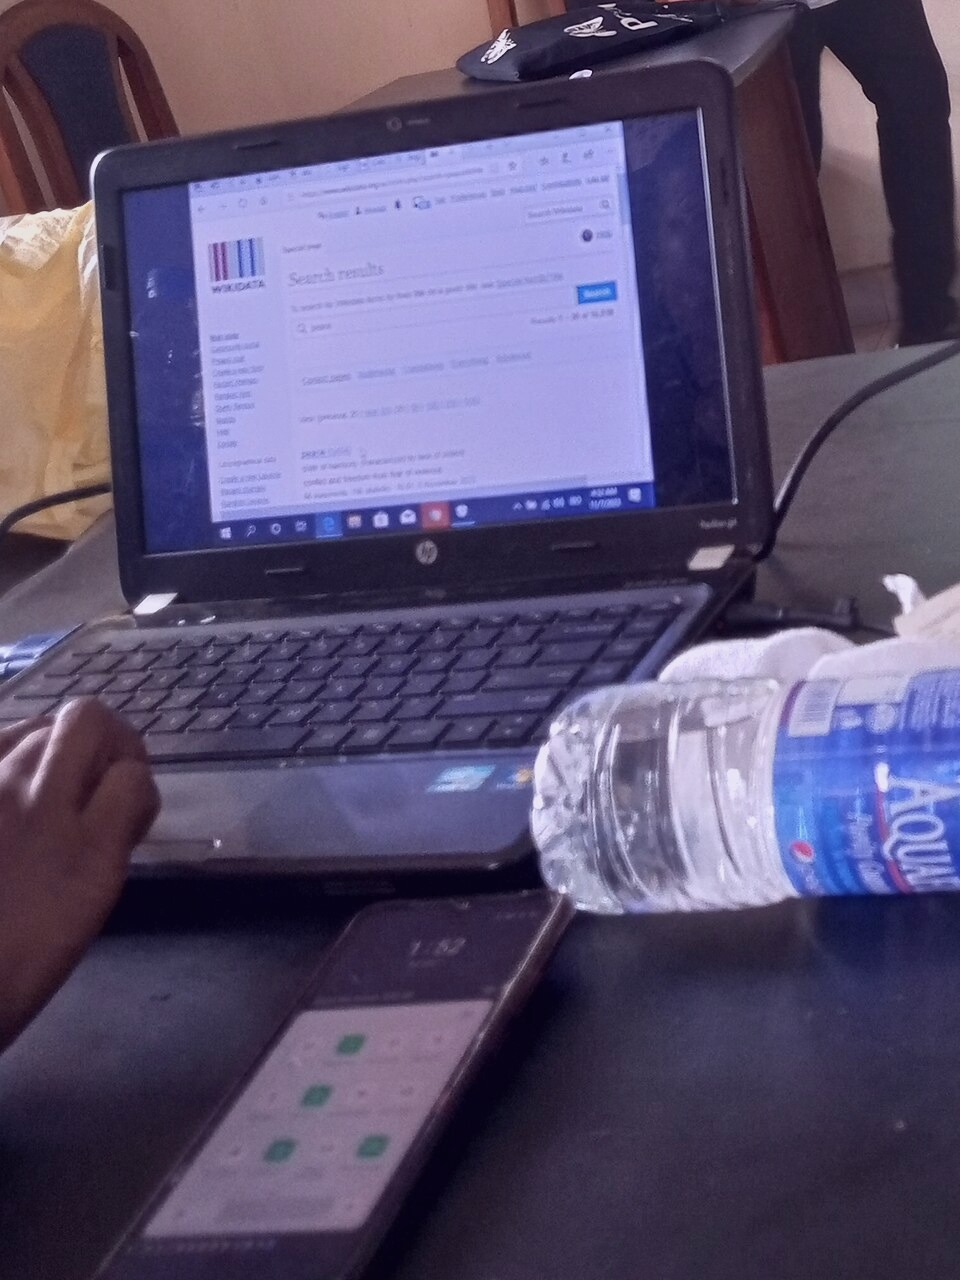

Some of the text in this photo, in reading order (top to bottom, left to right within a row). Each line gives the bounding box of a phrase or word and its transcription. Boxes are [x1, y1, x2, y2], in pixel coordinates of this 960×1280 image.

[288, 263, 385, 287] Search results
[211, 280, 267, 294] WIKIDATA
